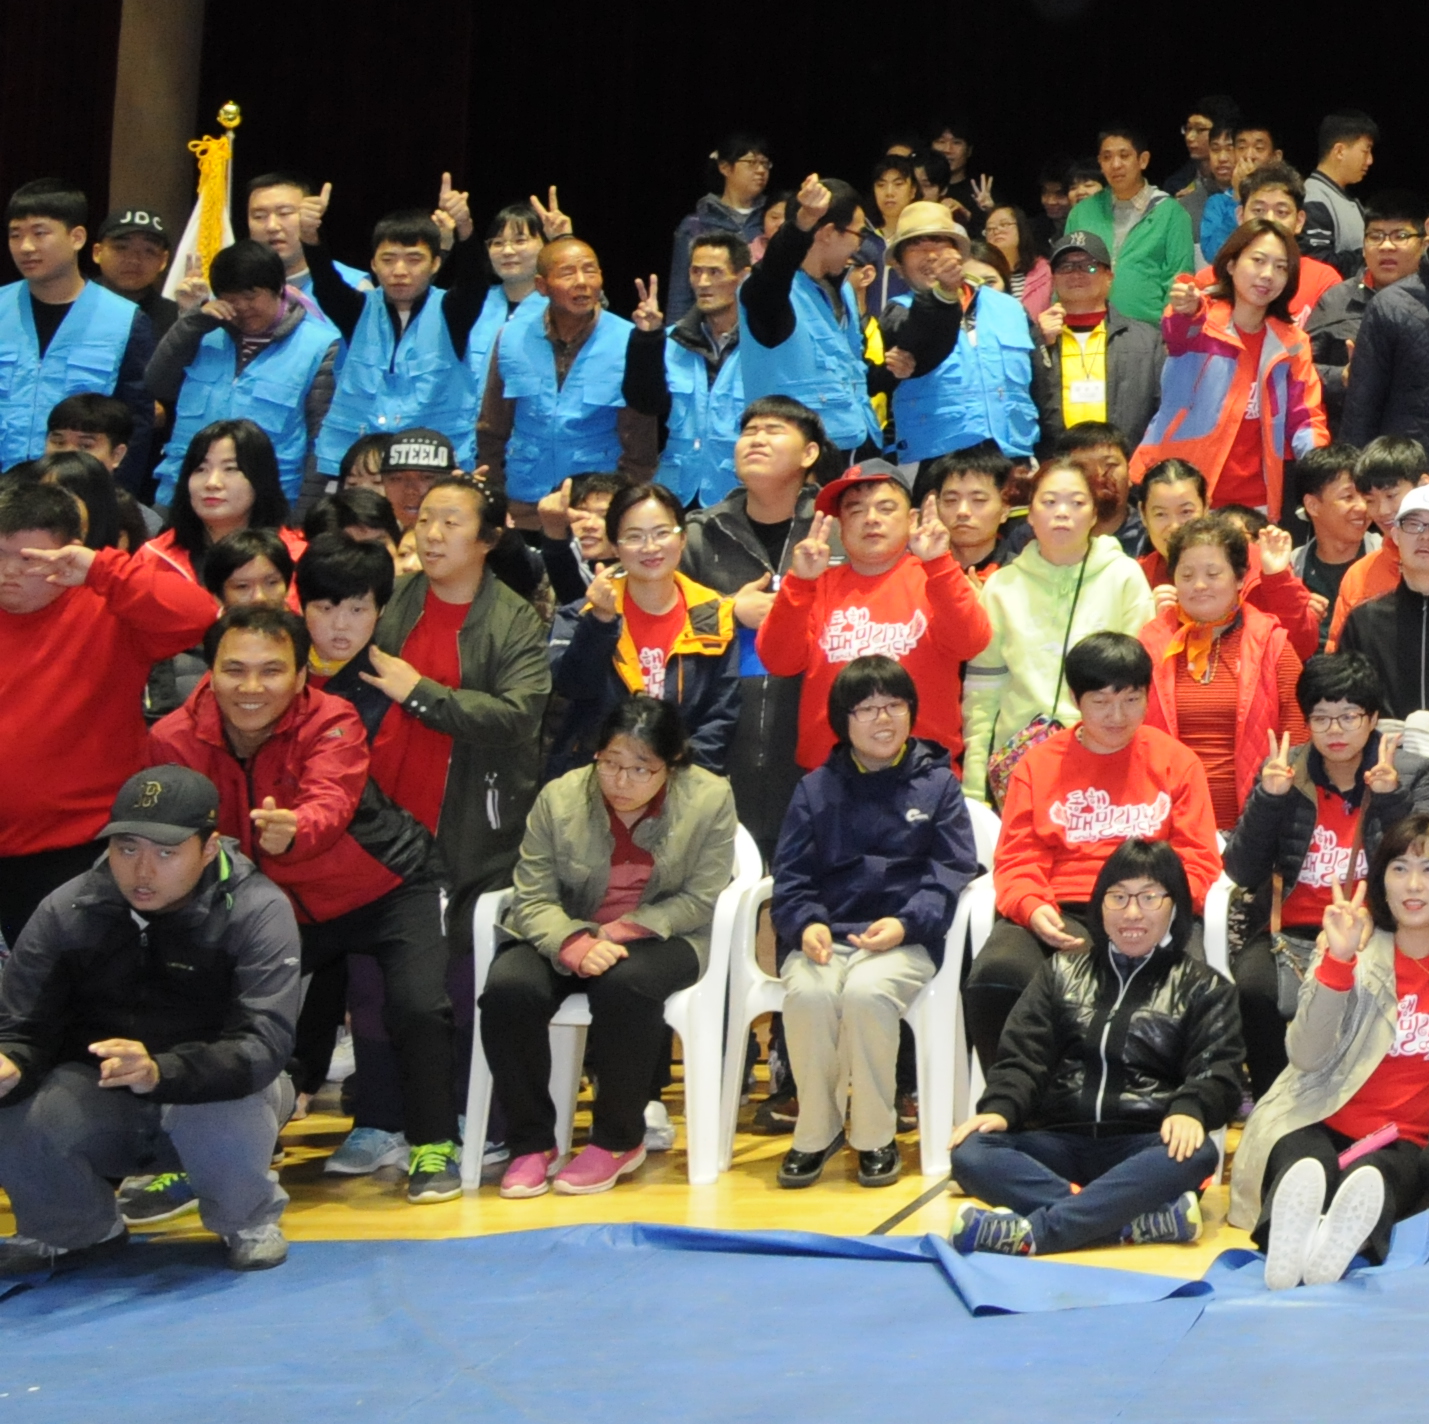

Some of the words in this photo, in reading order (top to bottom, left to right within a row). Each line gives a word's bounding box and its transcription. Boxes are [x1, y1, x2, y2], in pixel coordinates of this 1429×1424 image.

[120, 211, 163, 231] JDC
[389, 444, 448, 467] STEELO
[1067, 789, 1108, 813] 동행
